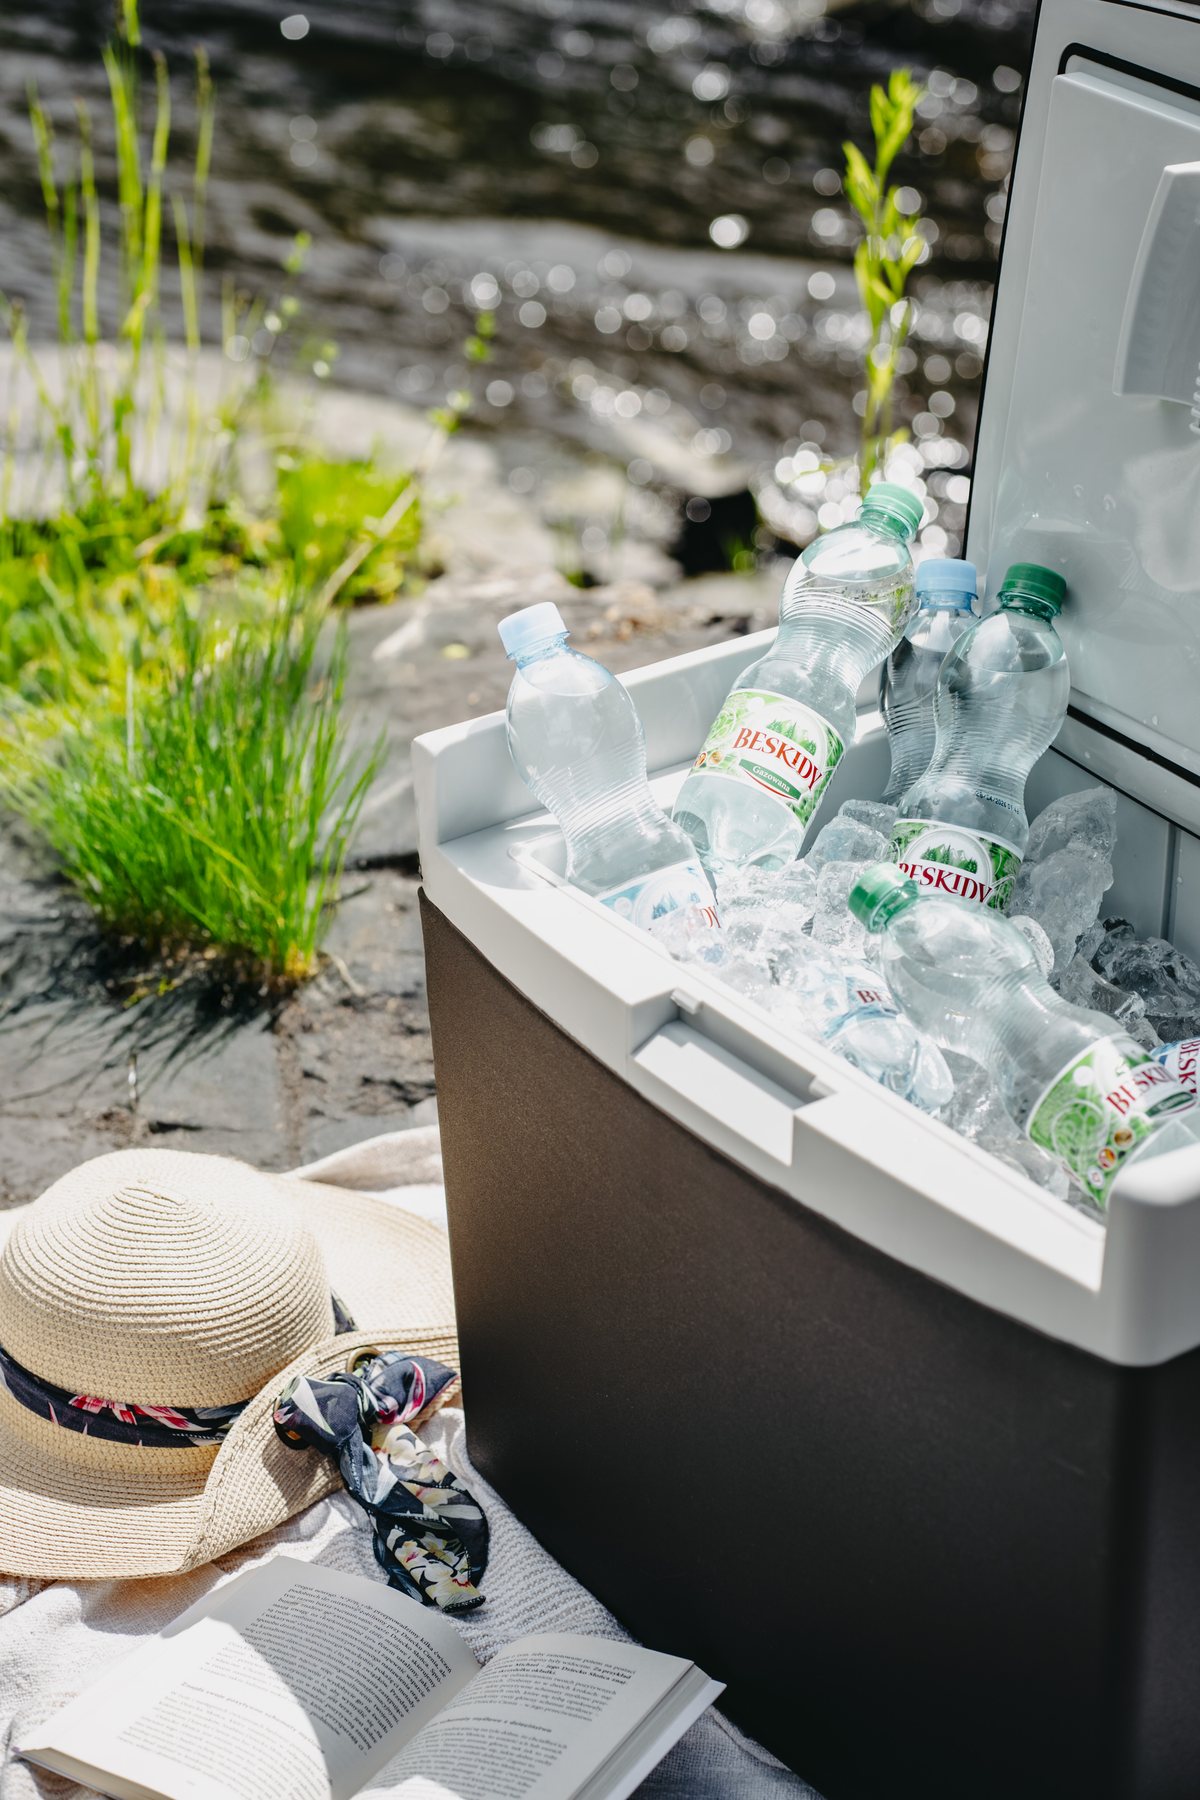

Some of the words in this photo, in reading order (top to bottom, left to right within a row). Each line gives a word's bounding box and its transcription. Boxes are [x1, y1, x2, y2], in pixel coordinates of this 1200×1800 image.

[732, 727, 823, 791] BESKIDY
[752, 764, 791, 793] Gazowana
[390, 1634, 412, 1651] Dziecko
[401, 1632, 423, 1650] Dziecku
[423, 1650, 439, 1669] Cienia,
[420, 1637, 433, 1651] kilka
[381, 1662, 410, 1690] nastawienia
[396, 1656, 419, 1678] ustalimy,
